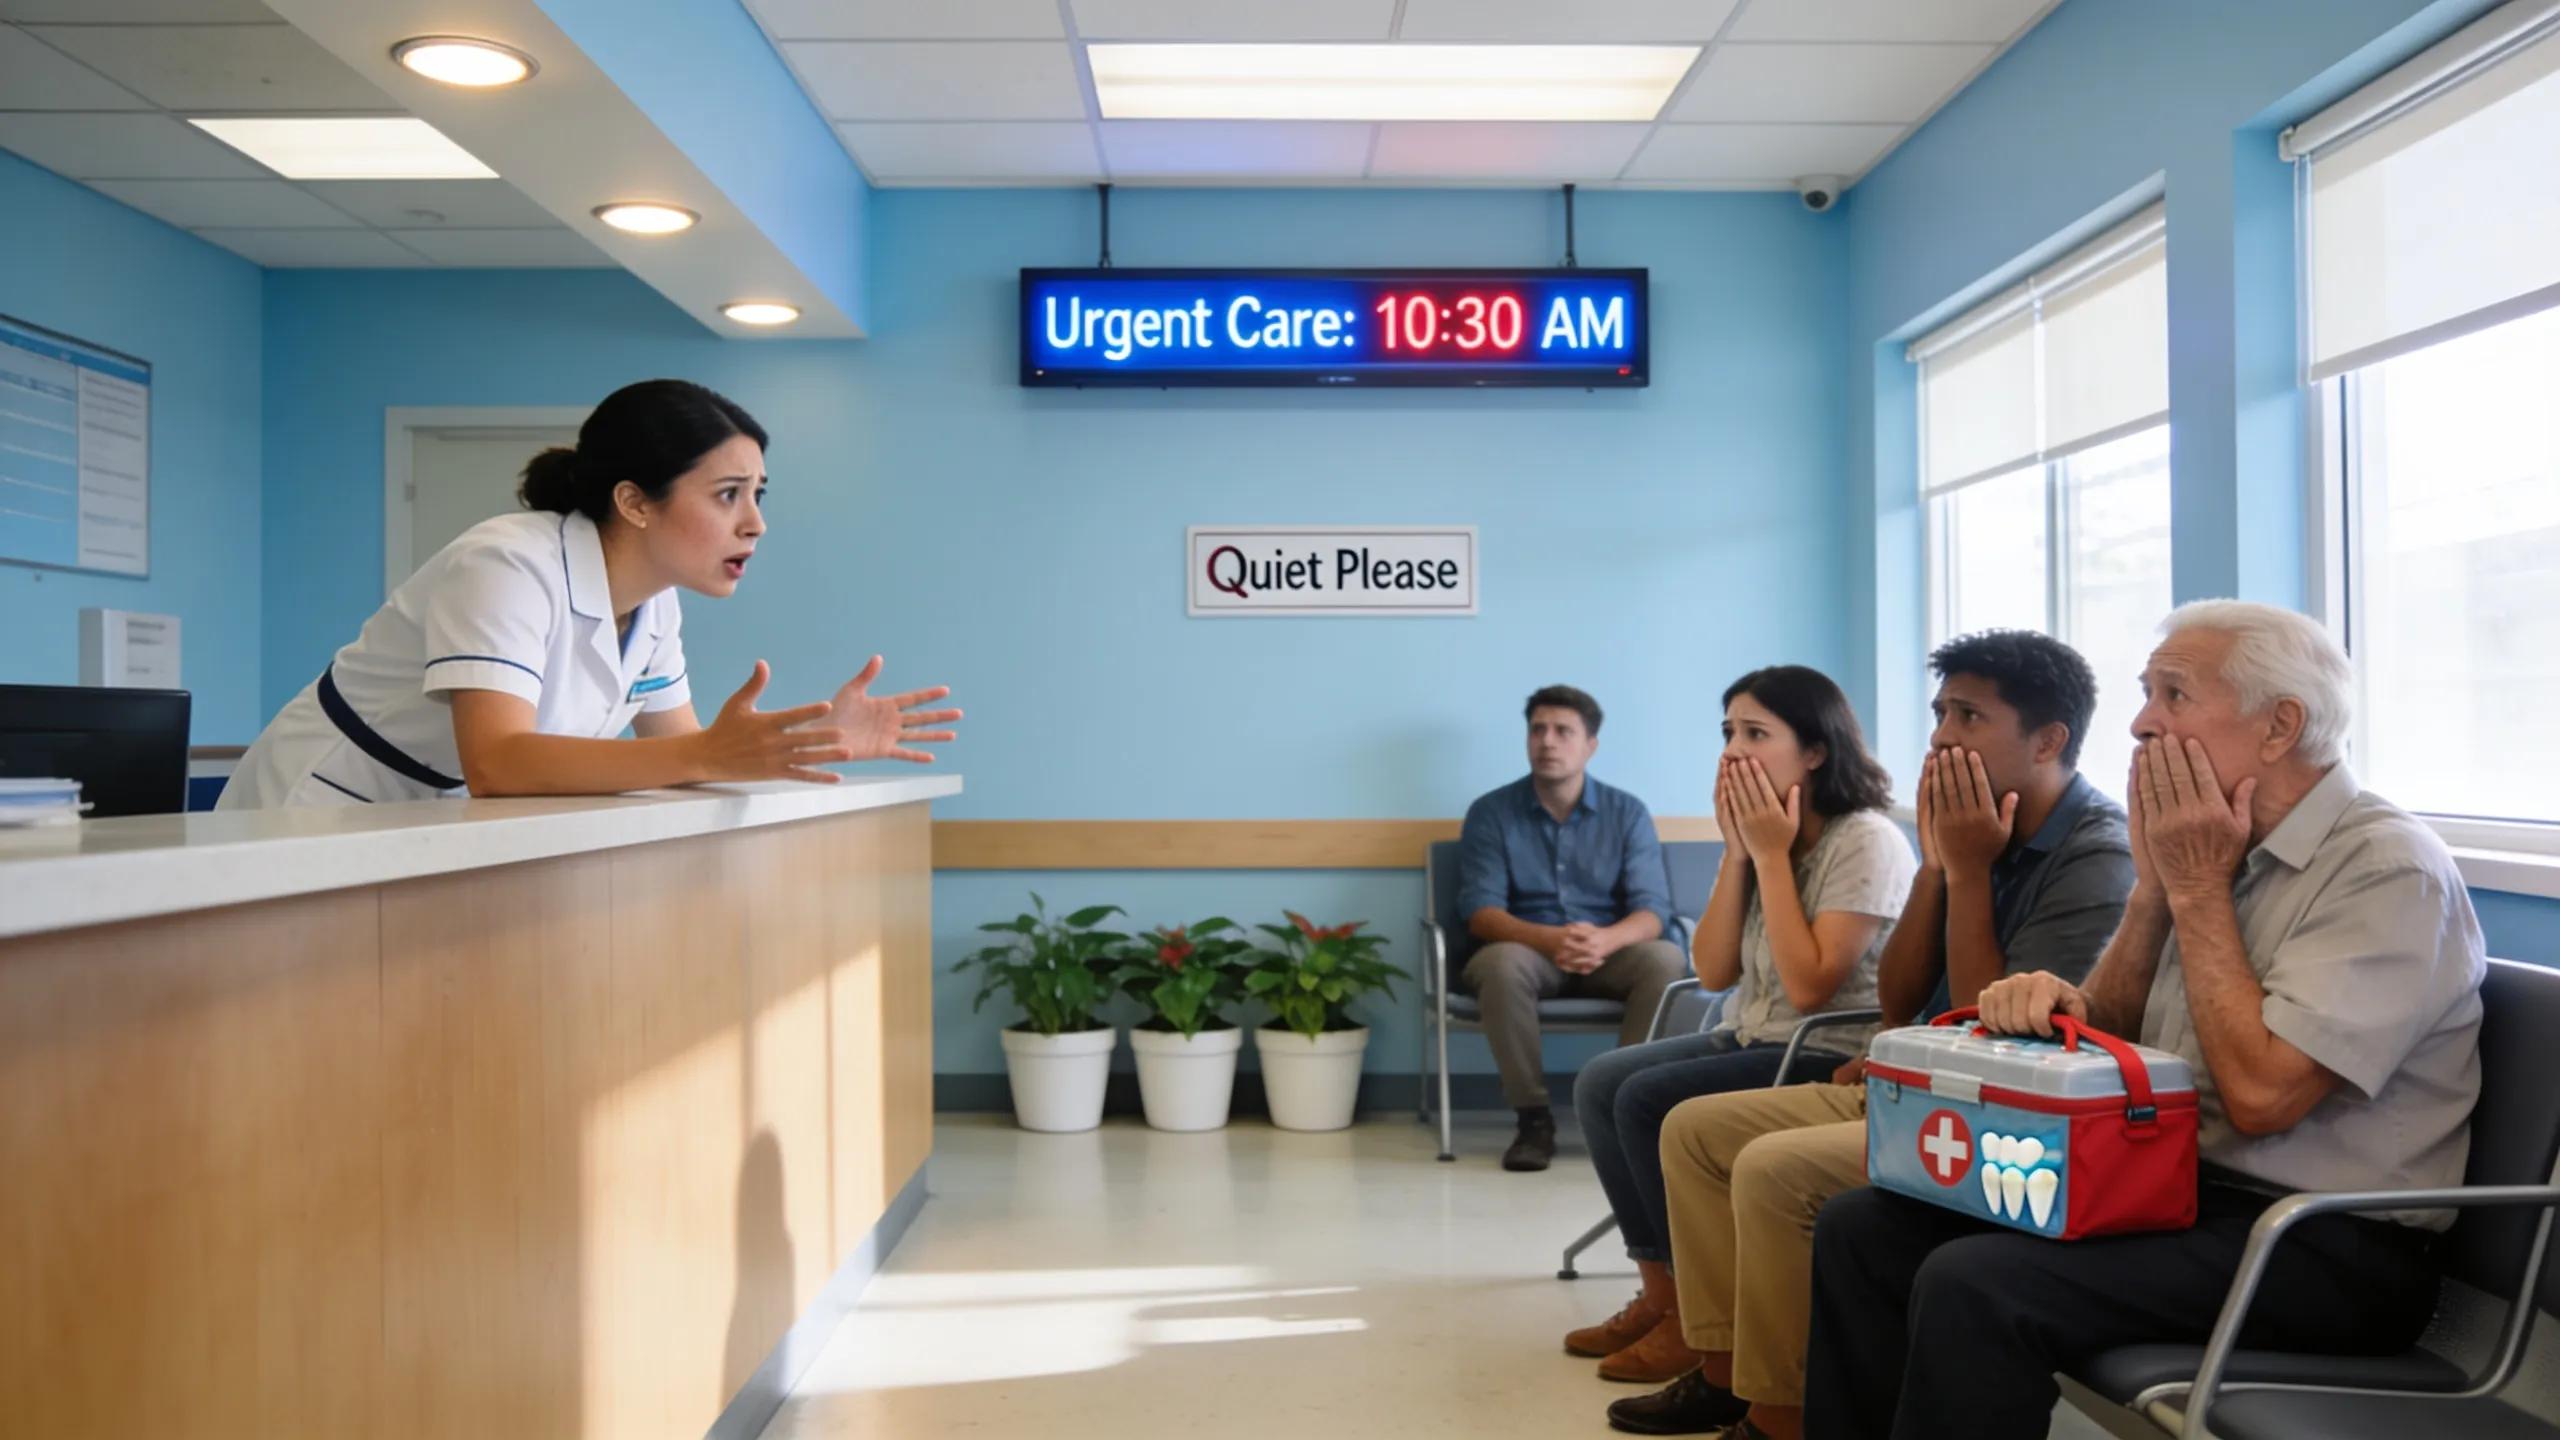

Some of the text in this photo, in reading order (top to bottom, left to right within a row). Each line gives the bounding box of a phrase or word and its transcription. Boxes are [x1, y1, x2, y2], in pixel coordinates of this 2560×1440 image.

[1045, 295, 1624, 361] Urgent Care: 10:30 AM
[1206, 545, 1458, 598] Quiet Please
